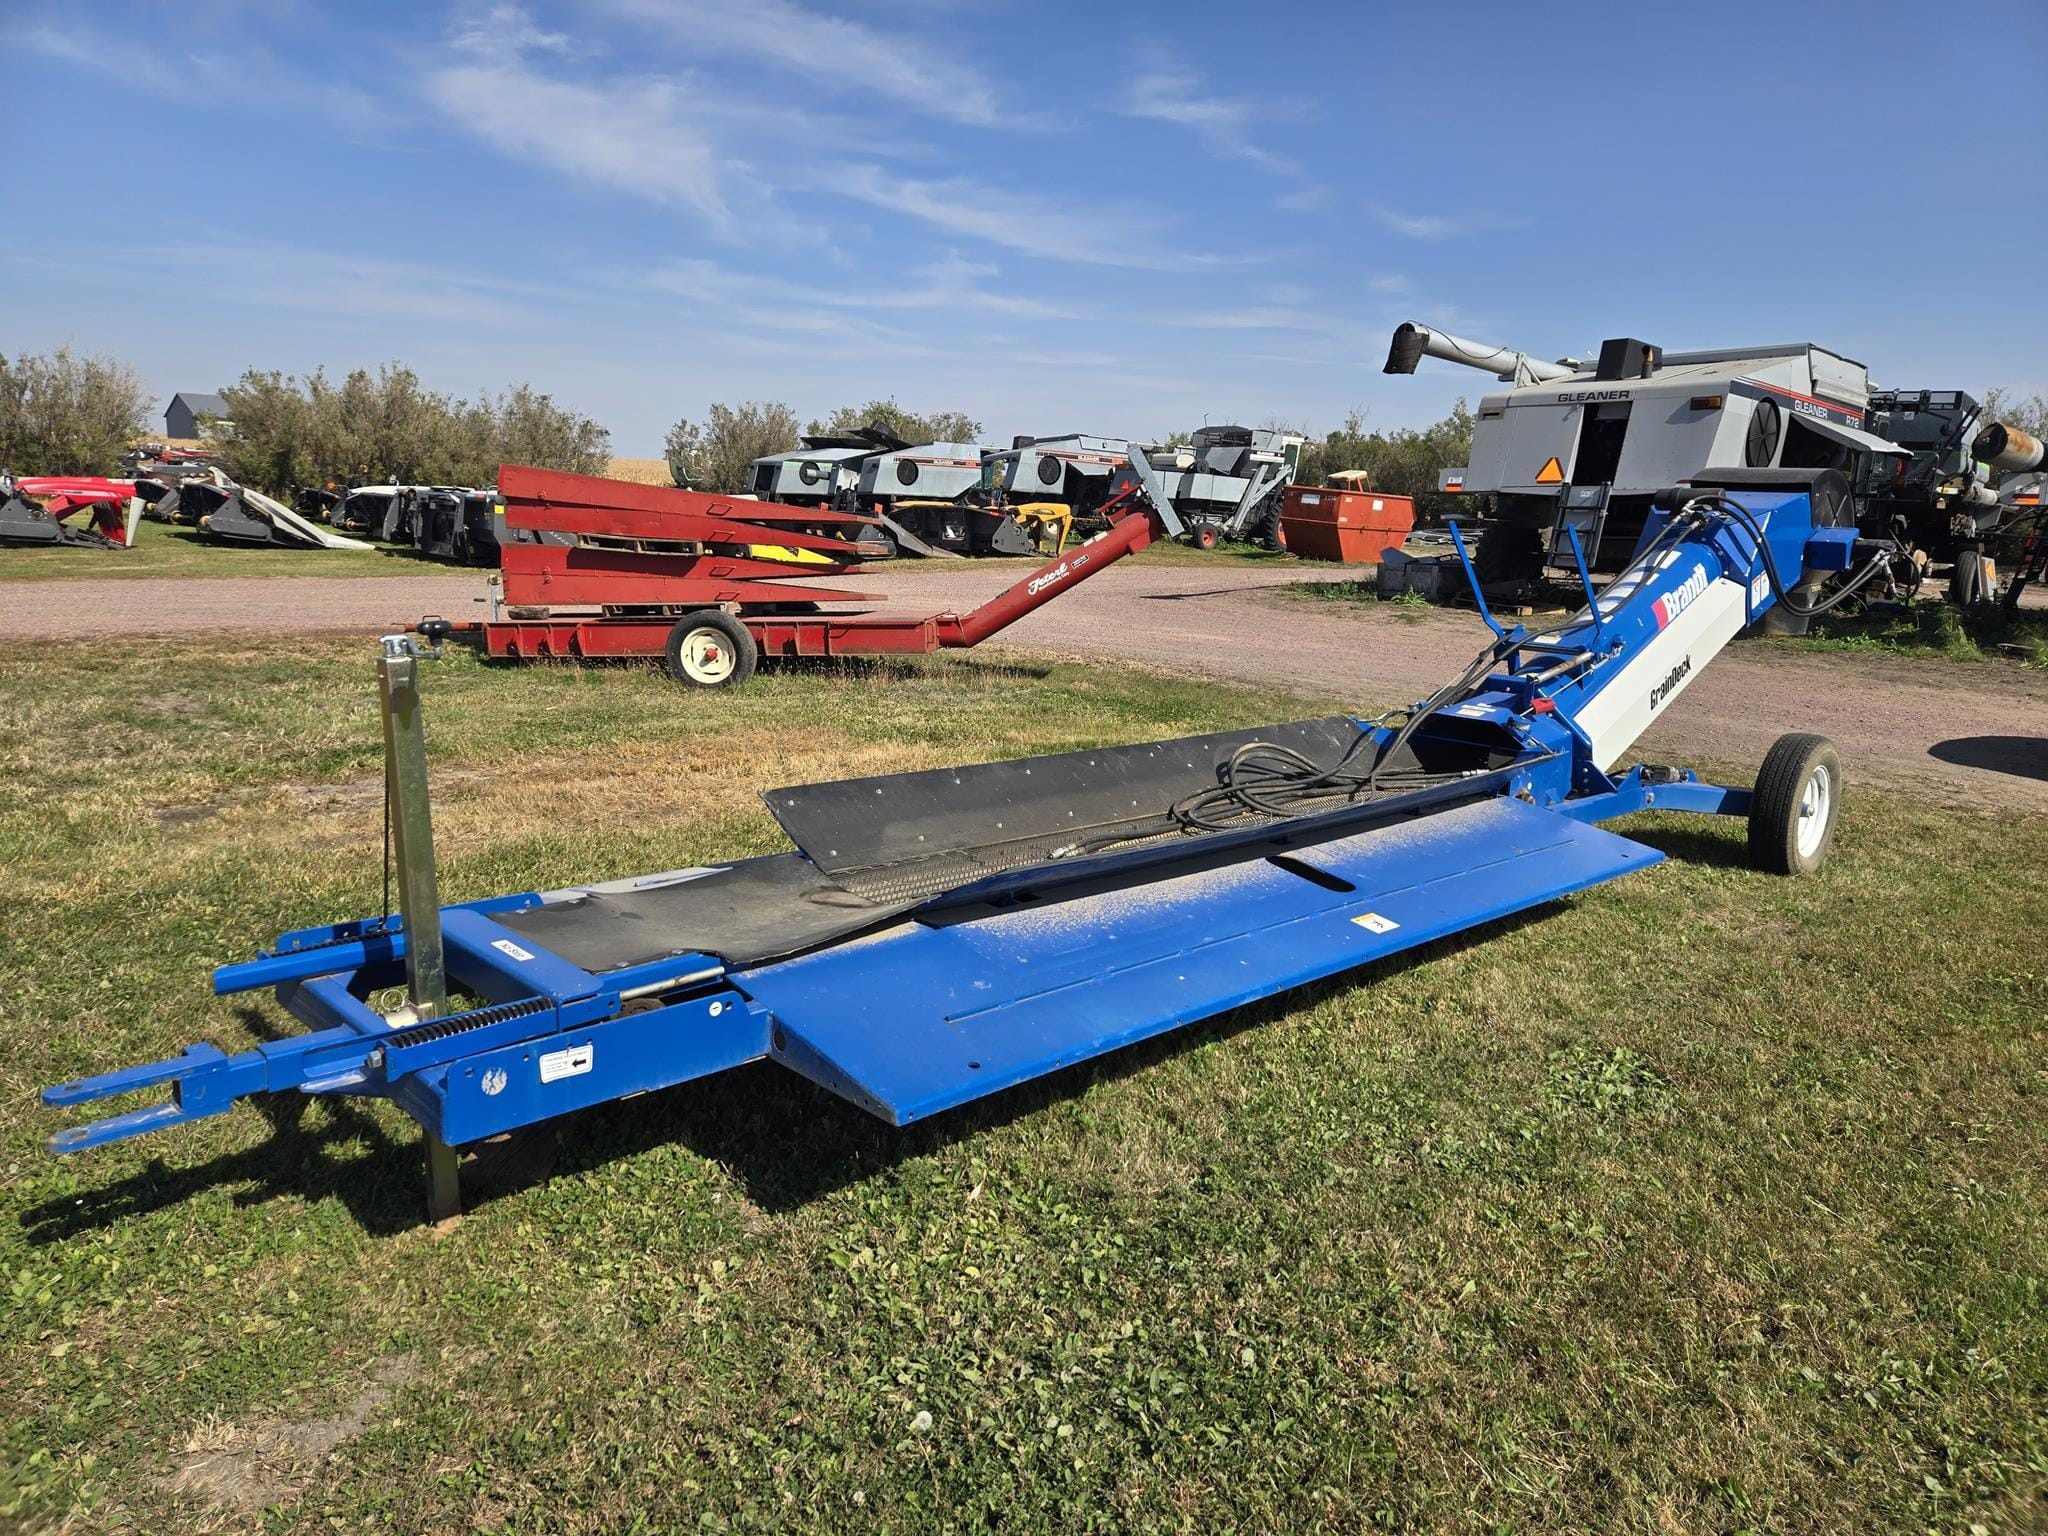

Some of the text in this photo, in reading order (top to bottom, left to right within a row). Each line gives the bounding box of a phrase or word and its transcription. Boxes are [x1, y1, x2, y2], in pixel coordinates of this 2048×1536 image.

[1558, 390, 1630, 402] GLEANER
[1794, 400, 1860, 428] GLEANER R72
[1660, 562, 1709, 623] Brandt
[1650, 654, 1692, 710] GrainDeck
